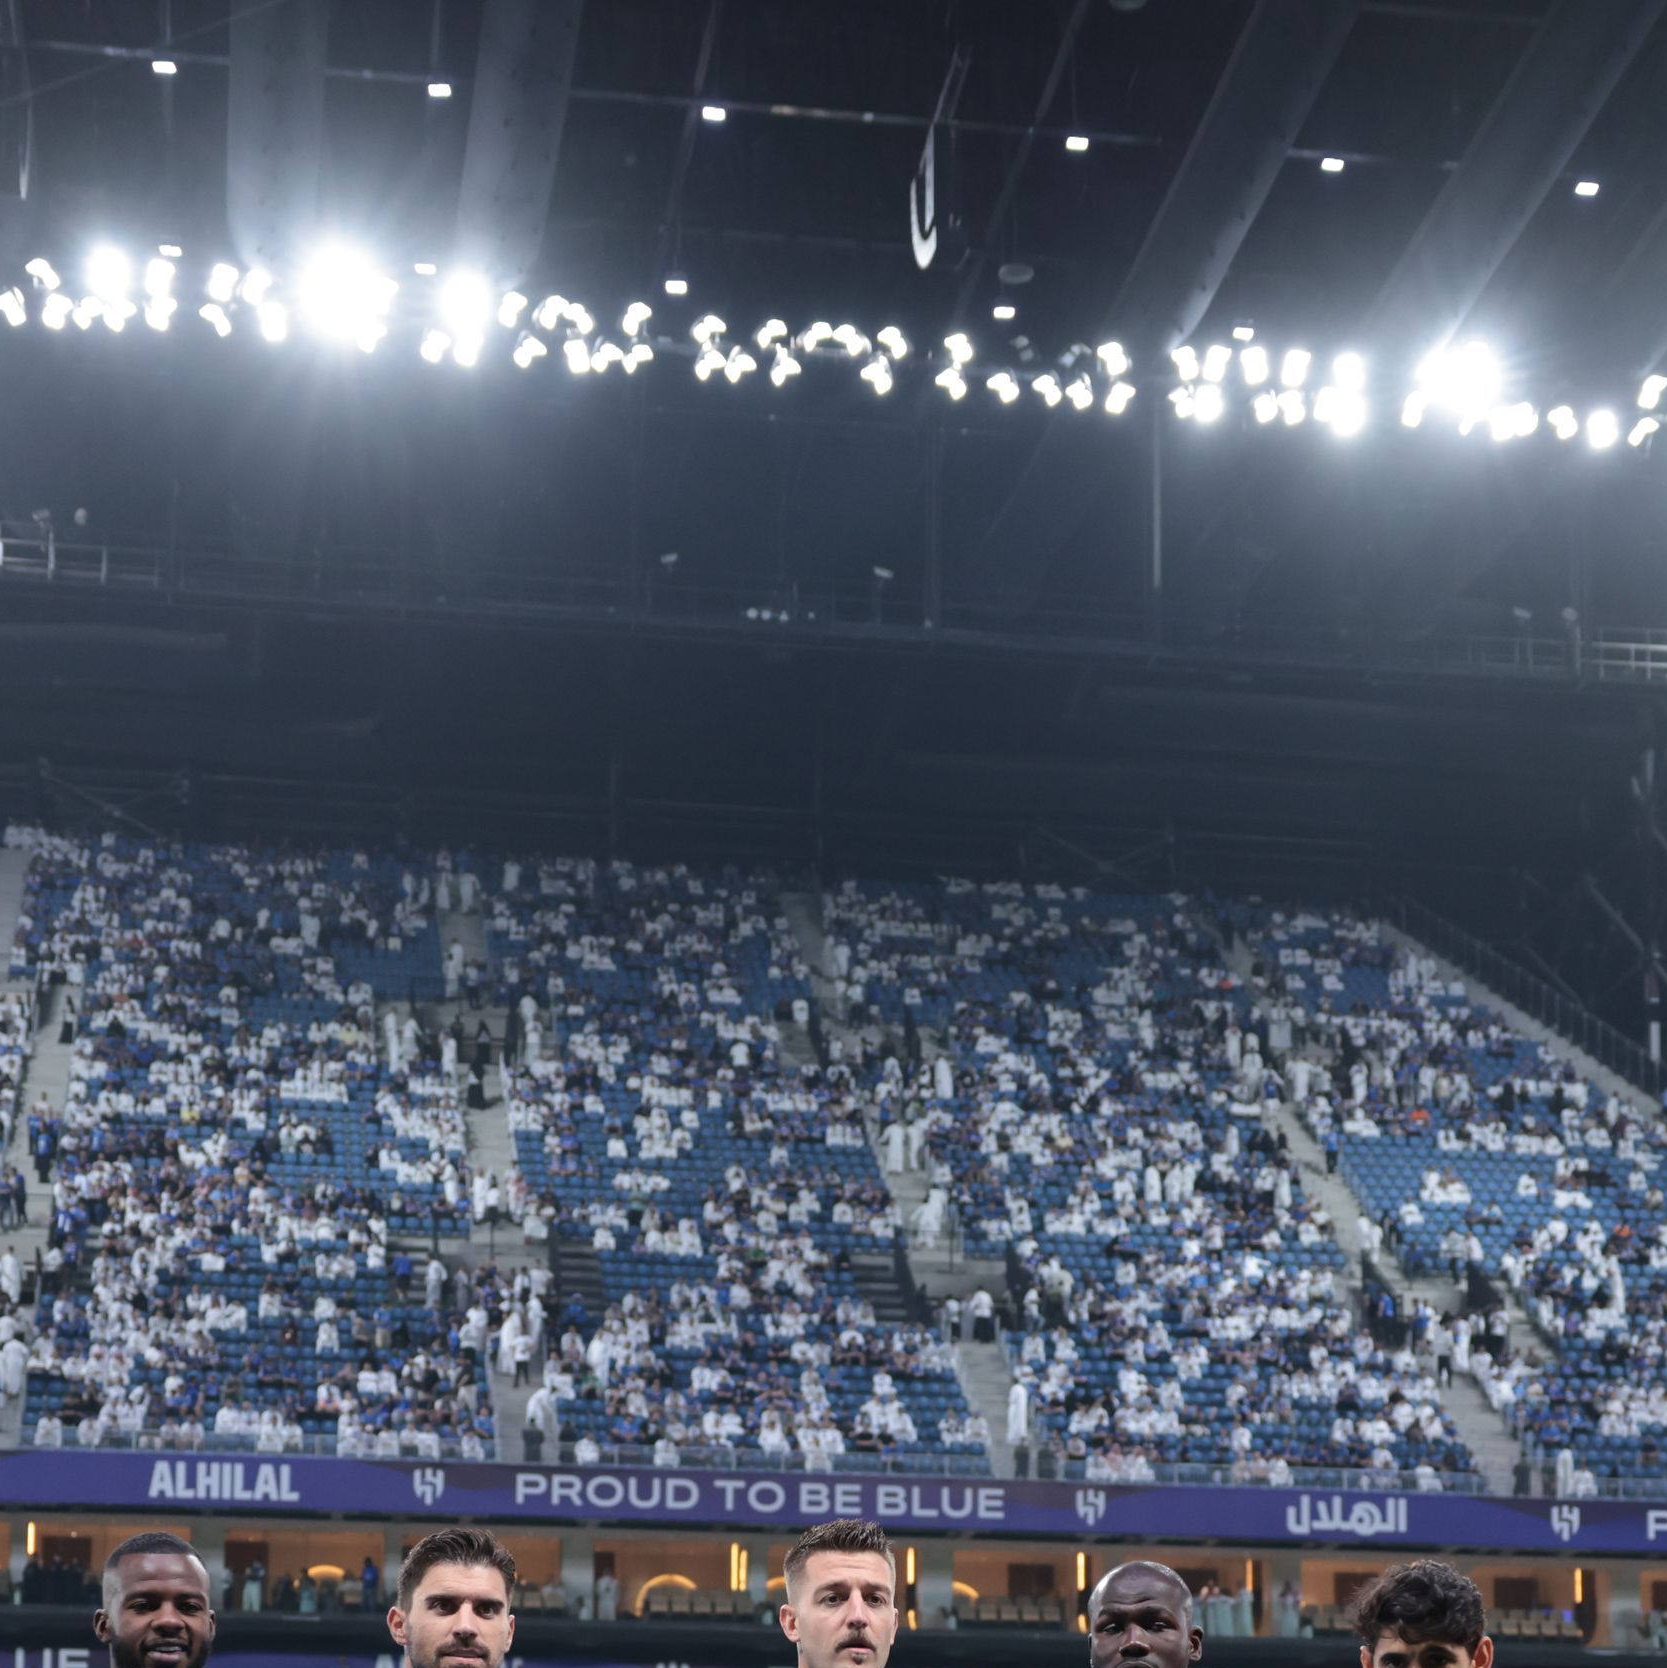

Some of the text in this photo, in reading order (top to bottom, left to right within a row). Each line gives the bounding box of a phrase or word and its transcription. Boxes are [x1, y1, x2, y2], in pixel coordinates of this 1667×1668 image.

[148, 1460, 300, 1502] ALHILAL
[515, 1472, 1006, 1519] PROUD TO BE BLUE
[1286, 1494, 1408, 1536] الهلال
